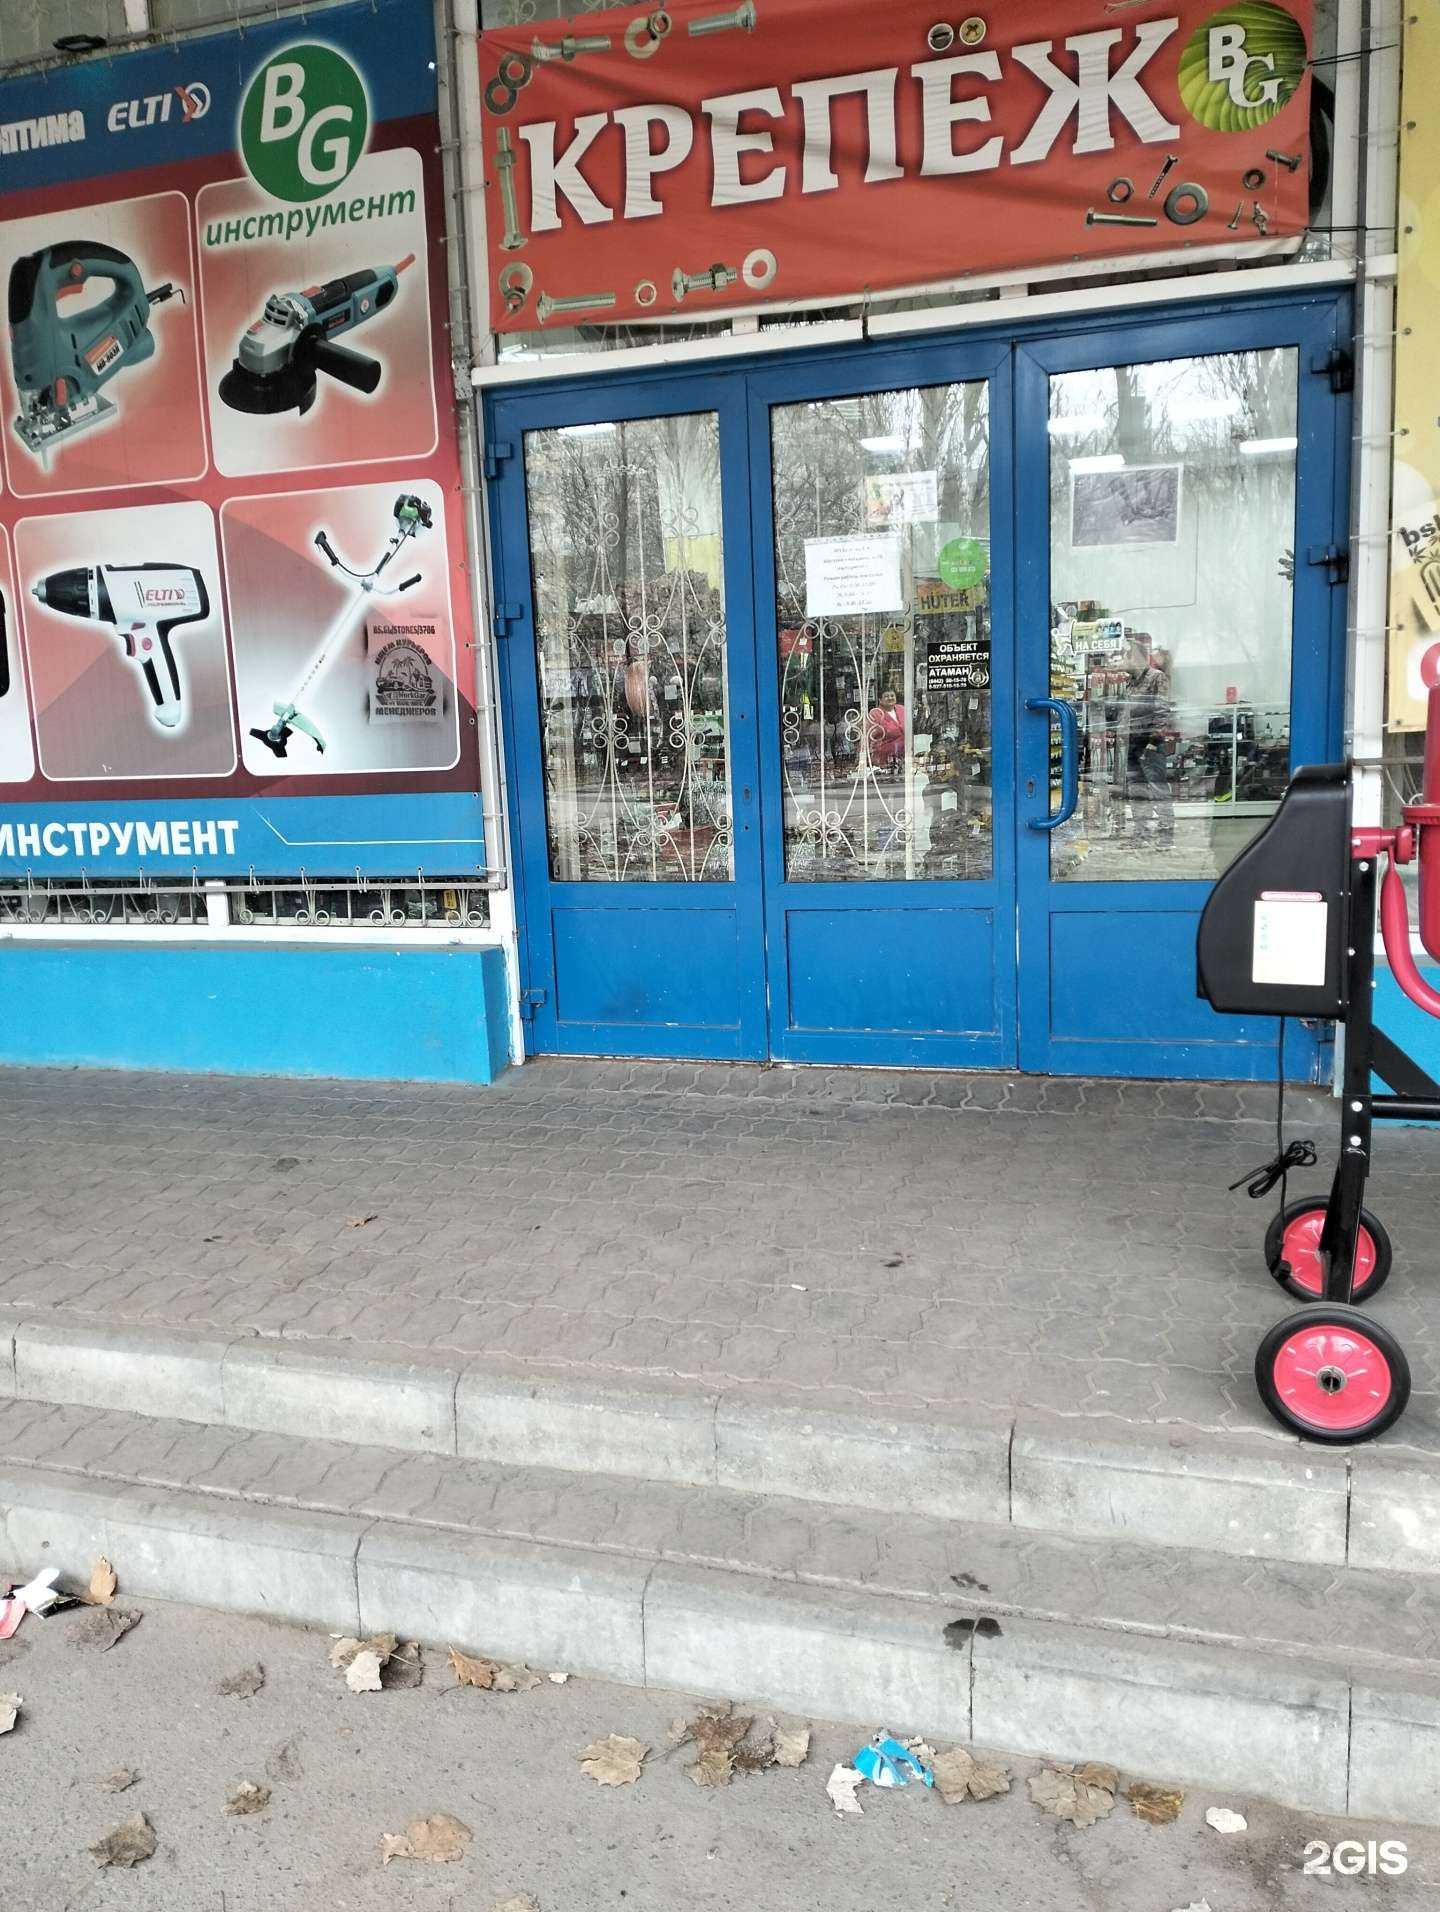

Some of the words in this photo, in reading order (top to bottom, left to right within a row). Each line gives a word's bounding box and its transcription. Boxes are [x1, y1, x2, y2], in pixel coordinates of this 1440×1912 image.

[107, 92, 172, 132] ELTI
[0, 110, 86, 155] птима
[205, 187, 416, 247] инструмент
[145, 588, 173, 601] ELTI
[939, 643, 978, 653] ОБЪЕКТ
[1075, 641, 1089, 651] НА
[1091, 639, 1117, 650] СЕБЯ
[928, 652, 990, 663] ОХРАНЯЕТСЯ
[928, 667, 969, 677] АТАМАН
[0, 819, 239, 857] ИНСТРУМЕНТ
